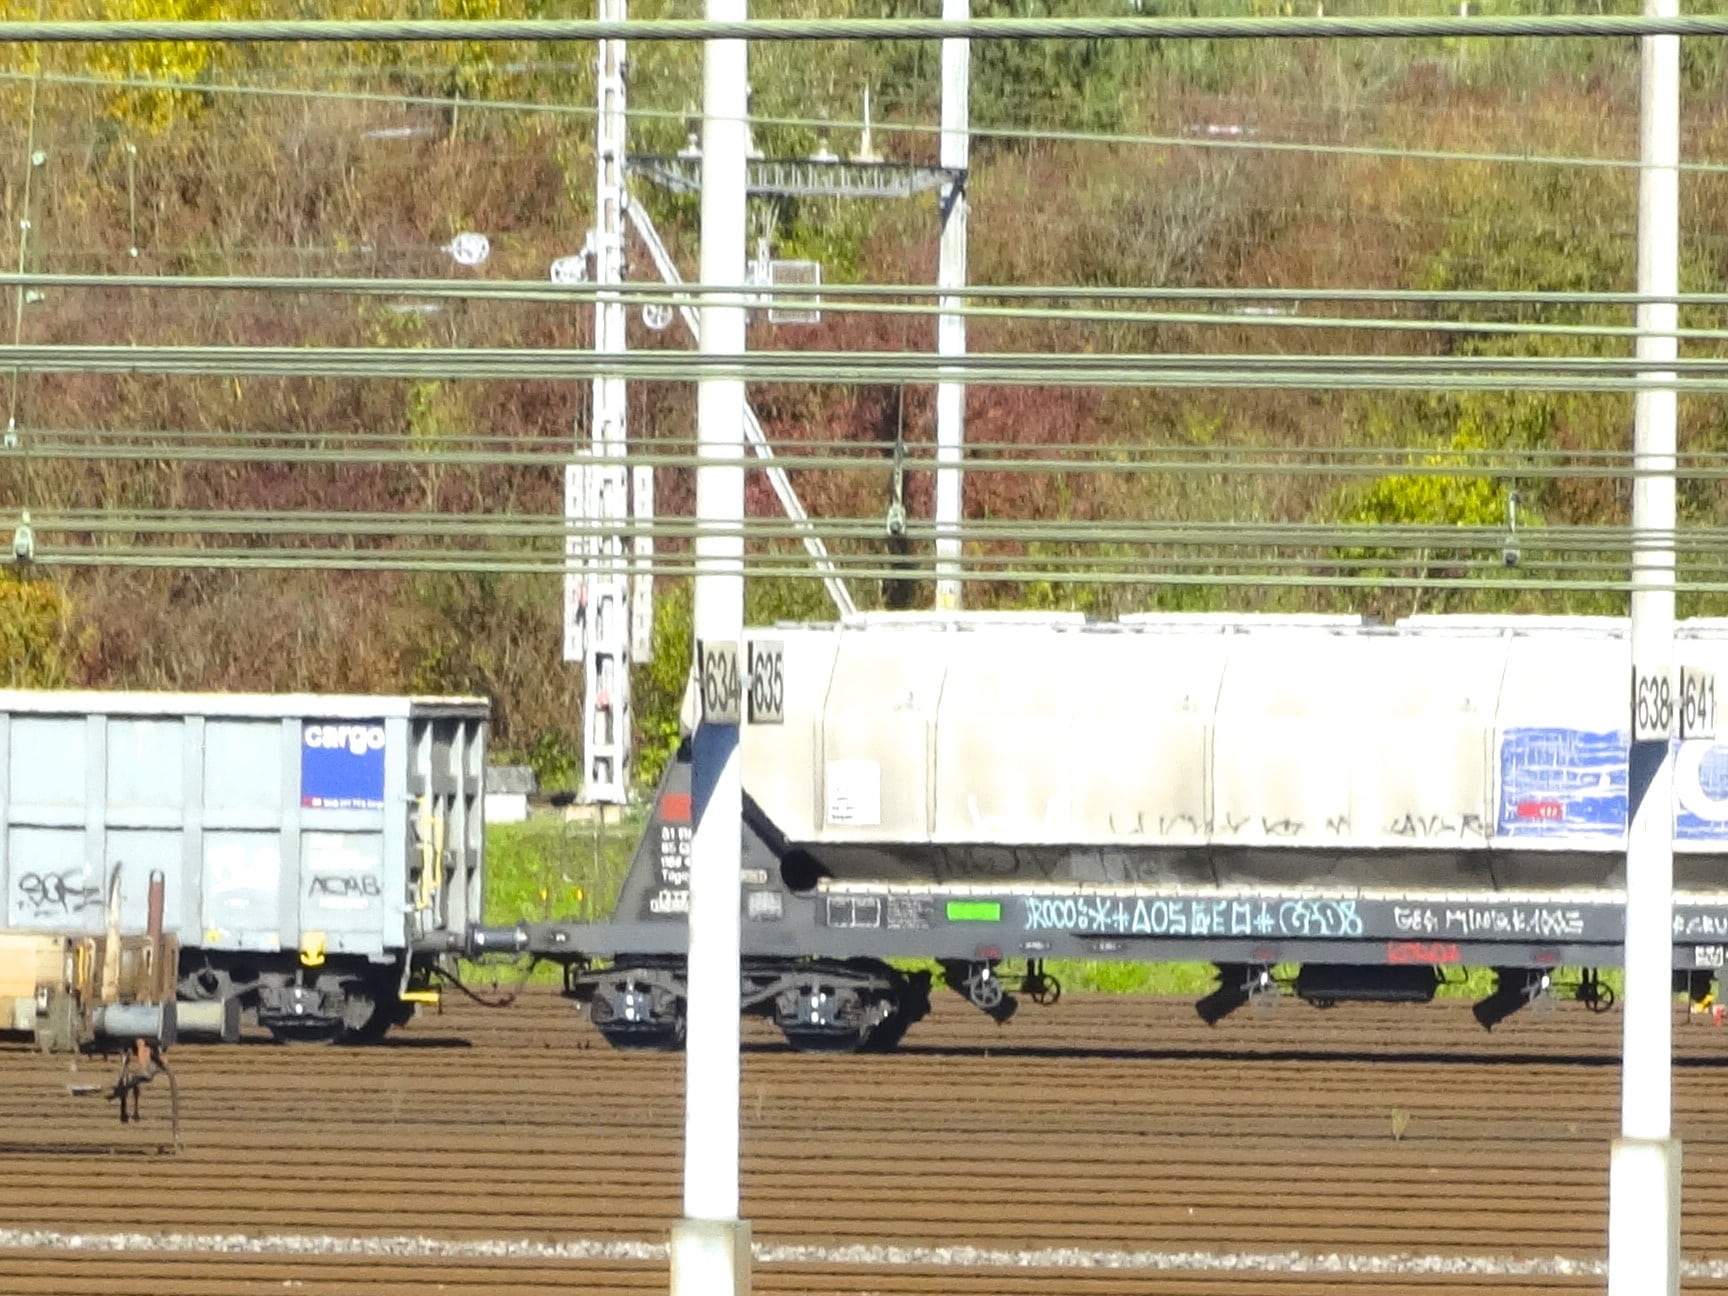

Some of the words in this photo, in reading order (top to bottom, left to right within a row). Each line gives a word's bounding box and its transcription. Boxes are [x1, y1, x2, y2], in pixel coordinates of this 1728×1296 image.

[706, 650, 740, 712] 634
[754, 651, 783, 714] 635
[1638, 676, 1669, 730] 638
[1686, 675, 1714, 730] 641
[305, 724, 385, 755] cargo
